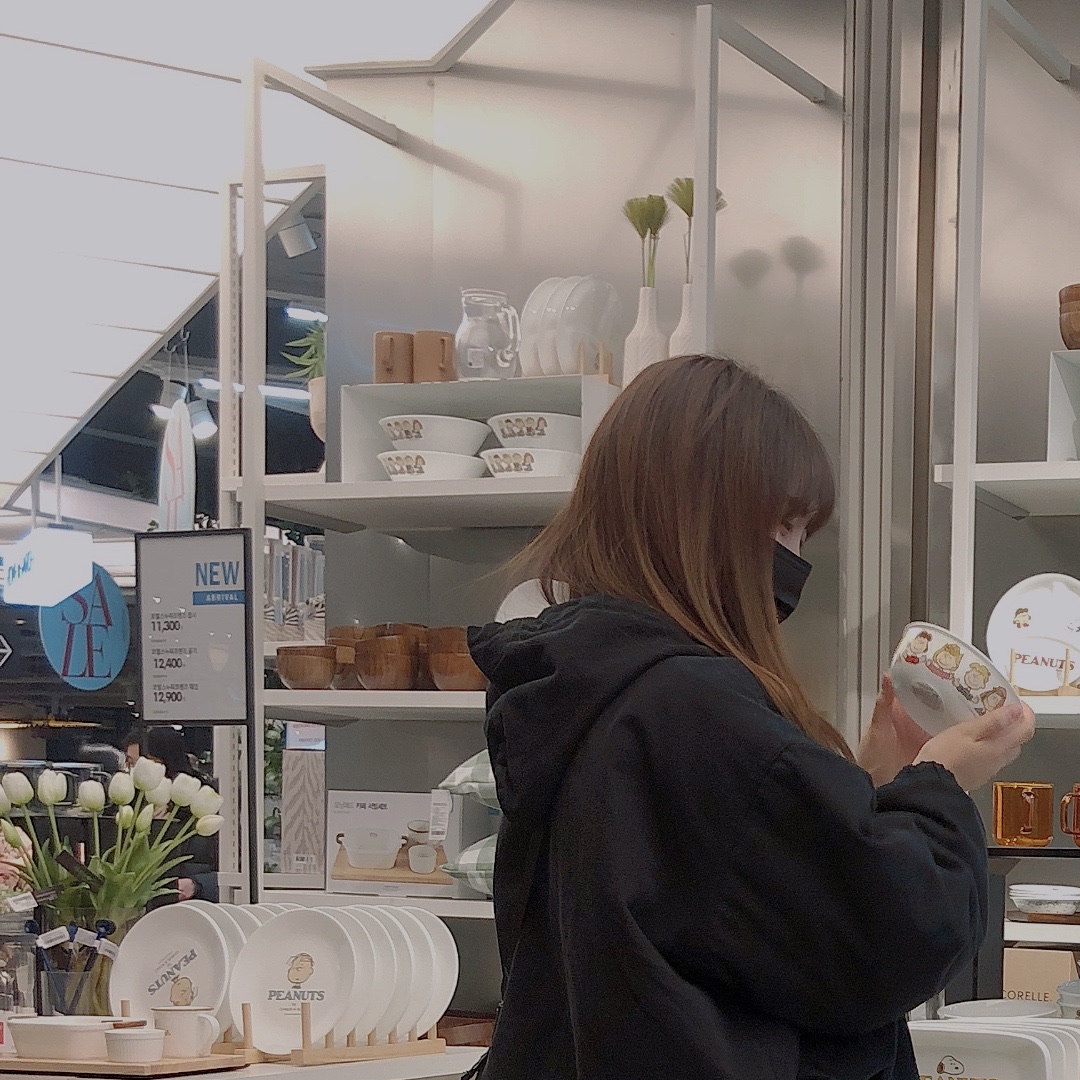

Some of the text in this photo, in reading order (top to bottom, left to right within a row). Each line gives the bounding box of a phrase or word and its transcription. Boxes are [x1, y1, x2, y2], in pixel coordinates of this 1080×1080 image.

[195, 561, 240, 586] NEW
[206, 593, 239, 601] ARRIVAL
[150, 620, 181, 634] 11,300
[153, 658, 183, 670] 12,400
[153, 691, 182, 703] 12,900
[148, 948, 198, 996] PEANUTS
[268, 990, 325, 1001] PEANUTS
